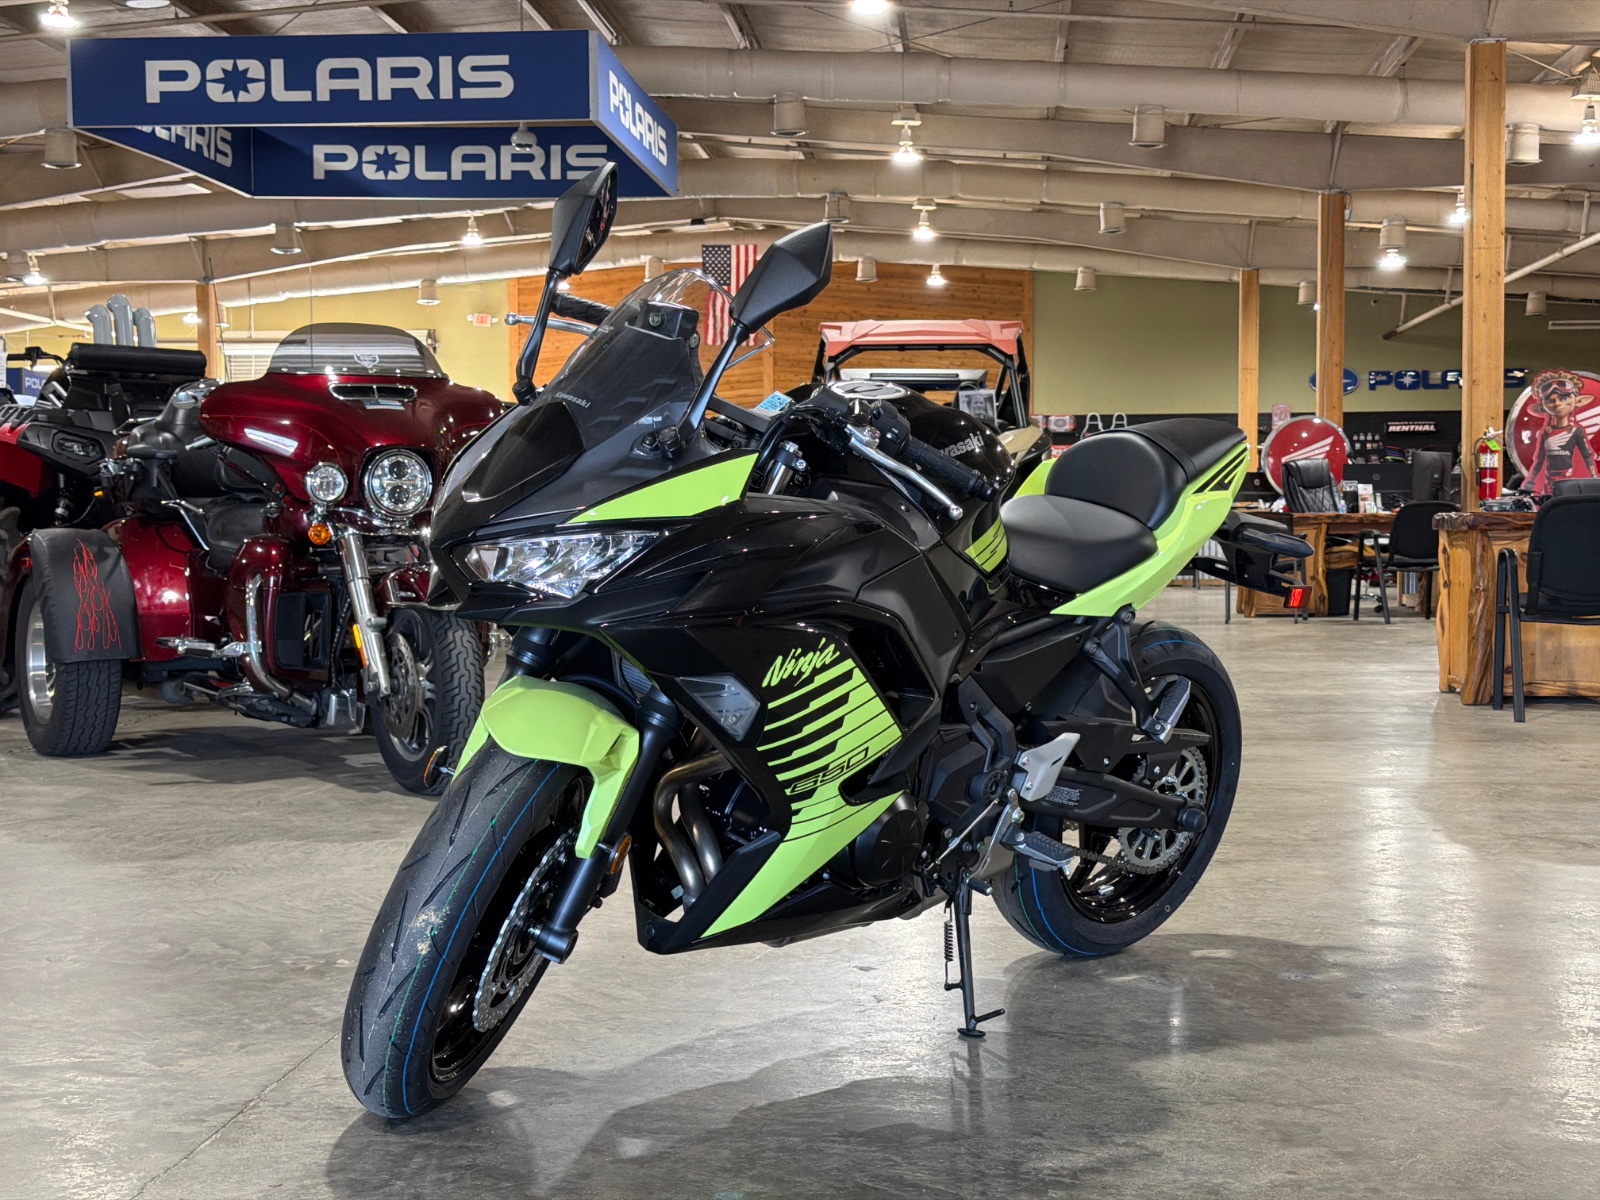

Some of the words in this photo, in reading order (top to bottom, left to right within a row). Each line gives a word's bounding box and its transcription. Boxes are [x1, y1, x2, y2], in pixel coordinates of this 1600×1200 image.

[145, 55, 515, 103] POLARIS
[609, 69, 667, 166] POLARIS
[313, 145, 609, 180] POLARIS
[1368, 368, 1526, 391] POLAS
[1388, 424, 1436, 432] RENTHAL
[762, 637, 840, 688] Ninja
[790, 746, 870, 794] 650
